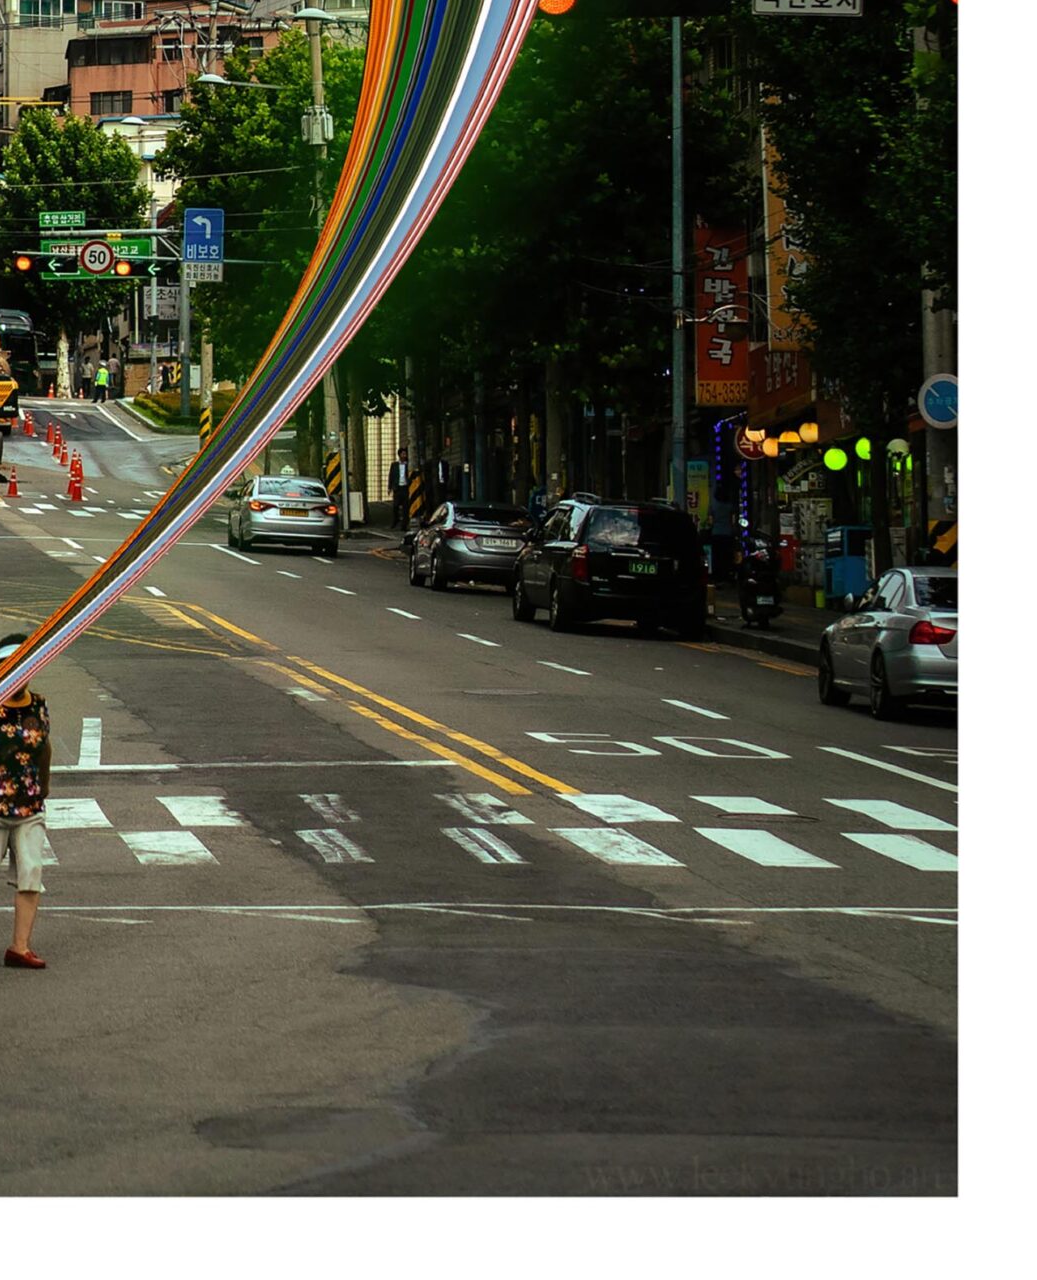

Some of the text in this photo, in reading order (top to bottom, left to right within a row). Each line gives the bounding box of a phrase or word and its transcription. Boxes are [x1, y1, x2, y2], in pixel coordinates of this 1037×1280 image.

[88, 250, 106, 265] 50
[186, 243, 220, 259] 비보호
[185, 263, 220, 272] 직진신호시
[698, 382, 748, 404] 754-3535
